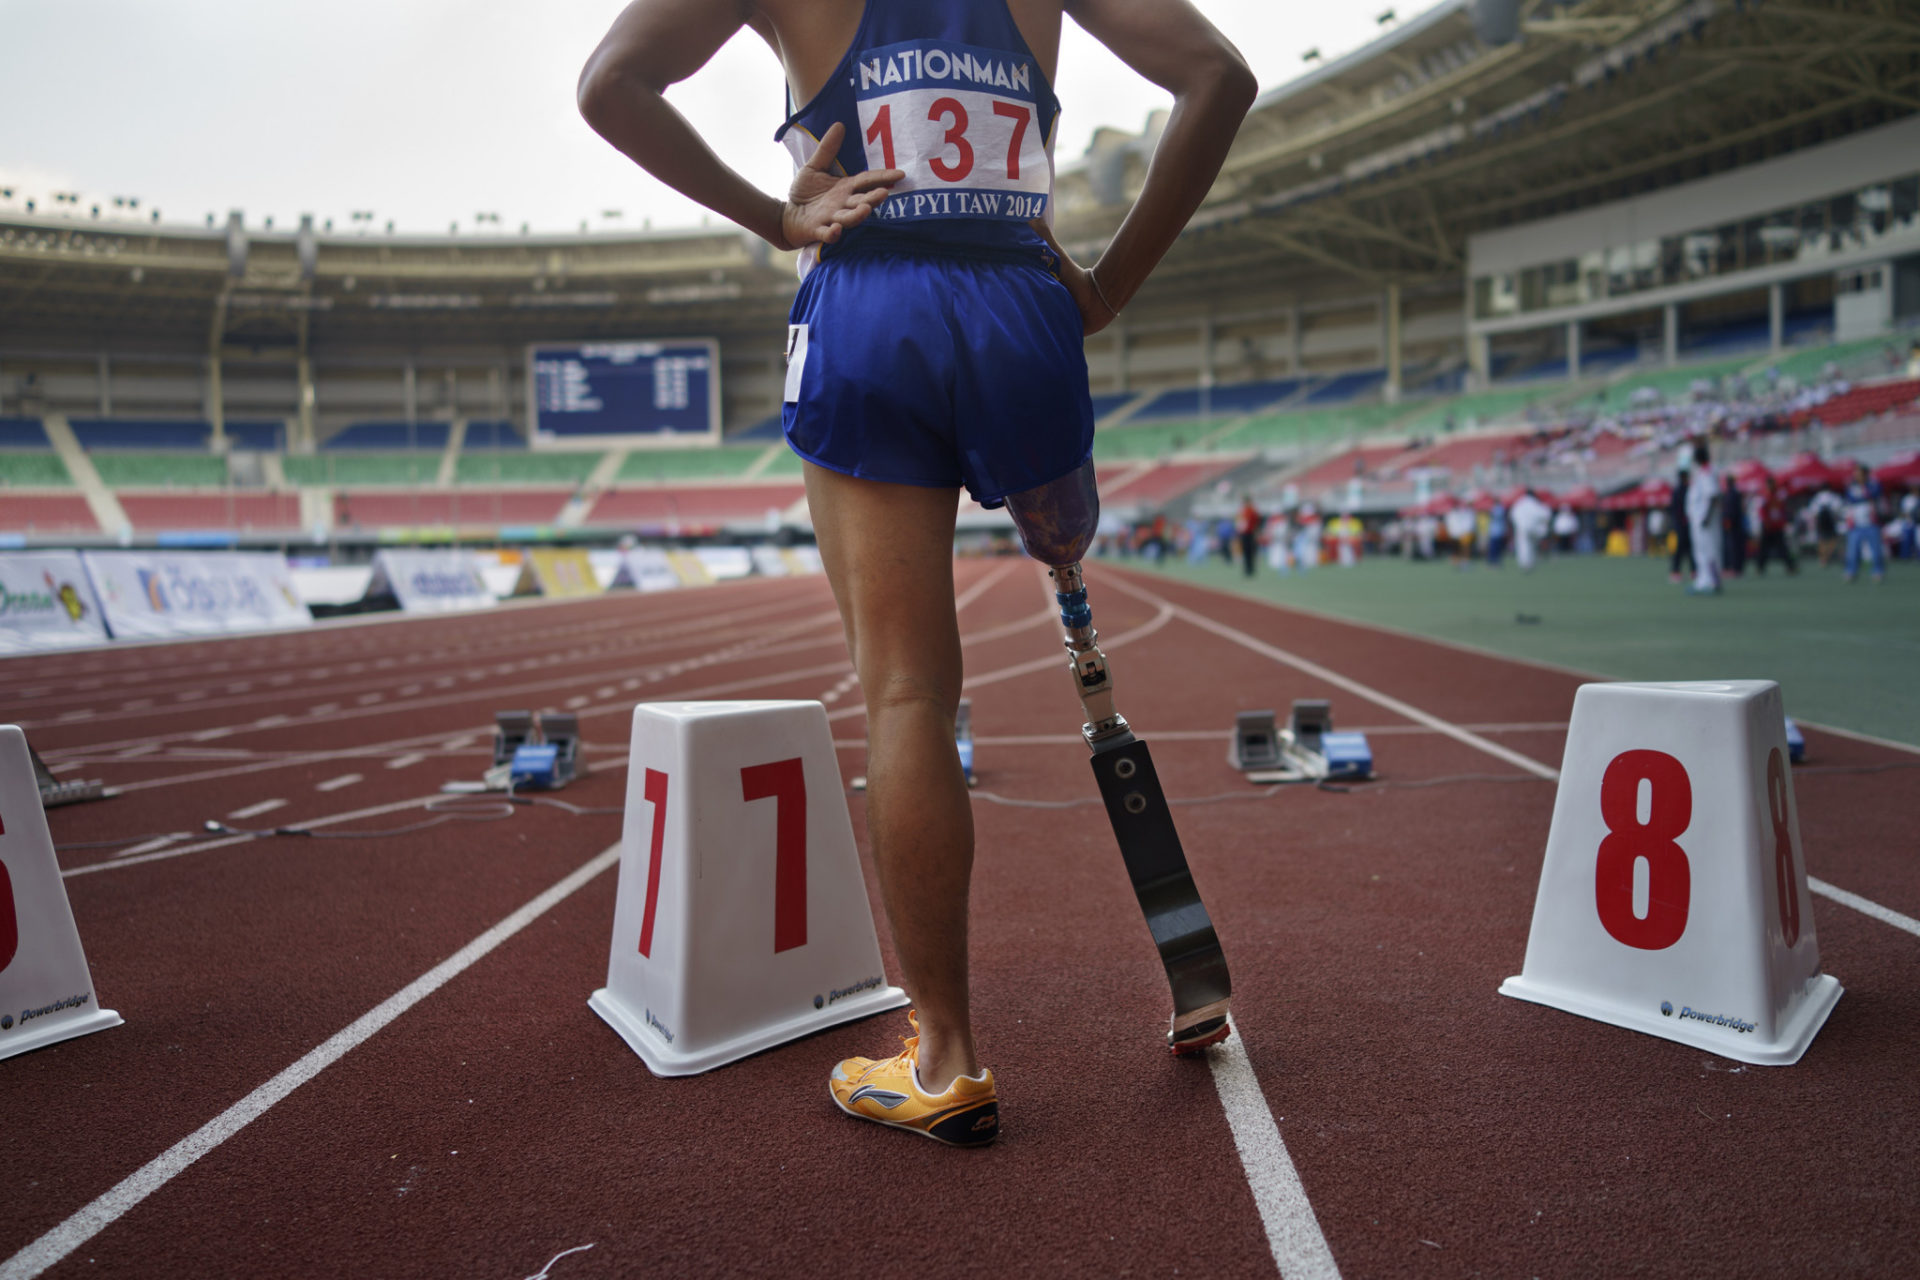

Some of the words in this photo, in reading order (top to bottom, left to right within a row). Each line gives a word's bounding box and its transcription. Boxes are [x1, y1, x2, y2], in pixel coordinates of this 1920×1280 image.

[860, 49, 1030, 93] NATIONMAN
[866, 97, 1031, 188] 137
[913, 193, 951, 216] PYI
[956, 193, 1001, 214] TAW
[1006, 195, 1042, 218] 2014
[638, 767, 669, 959] 7
[740, 757, 807, 954] 7
[1595, 749, 1692, 950] 8
[1767, 747, 1799, 949] 8
